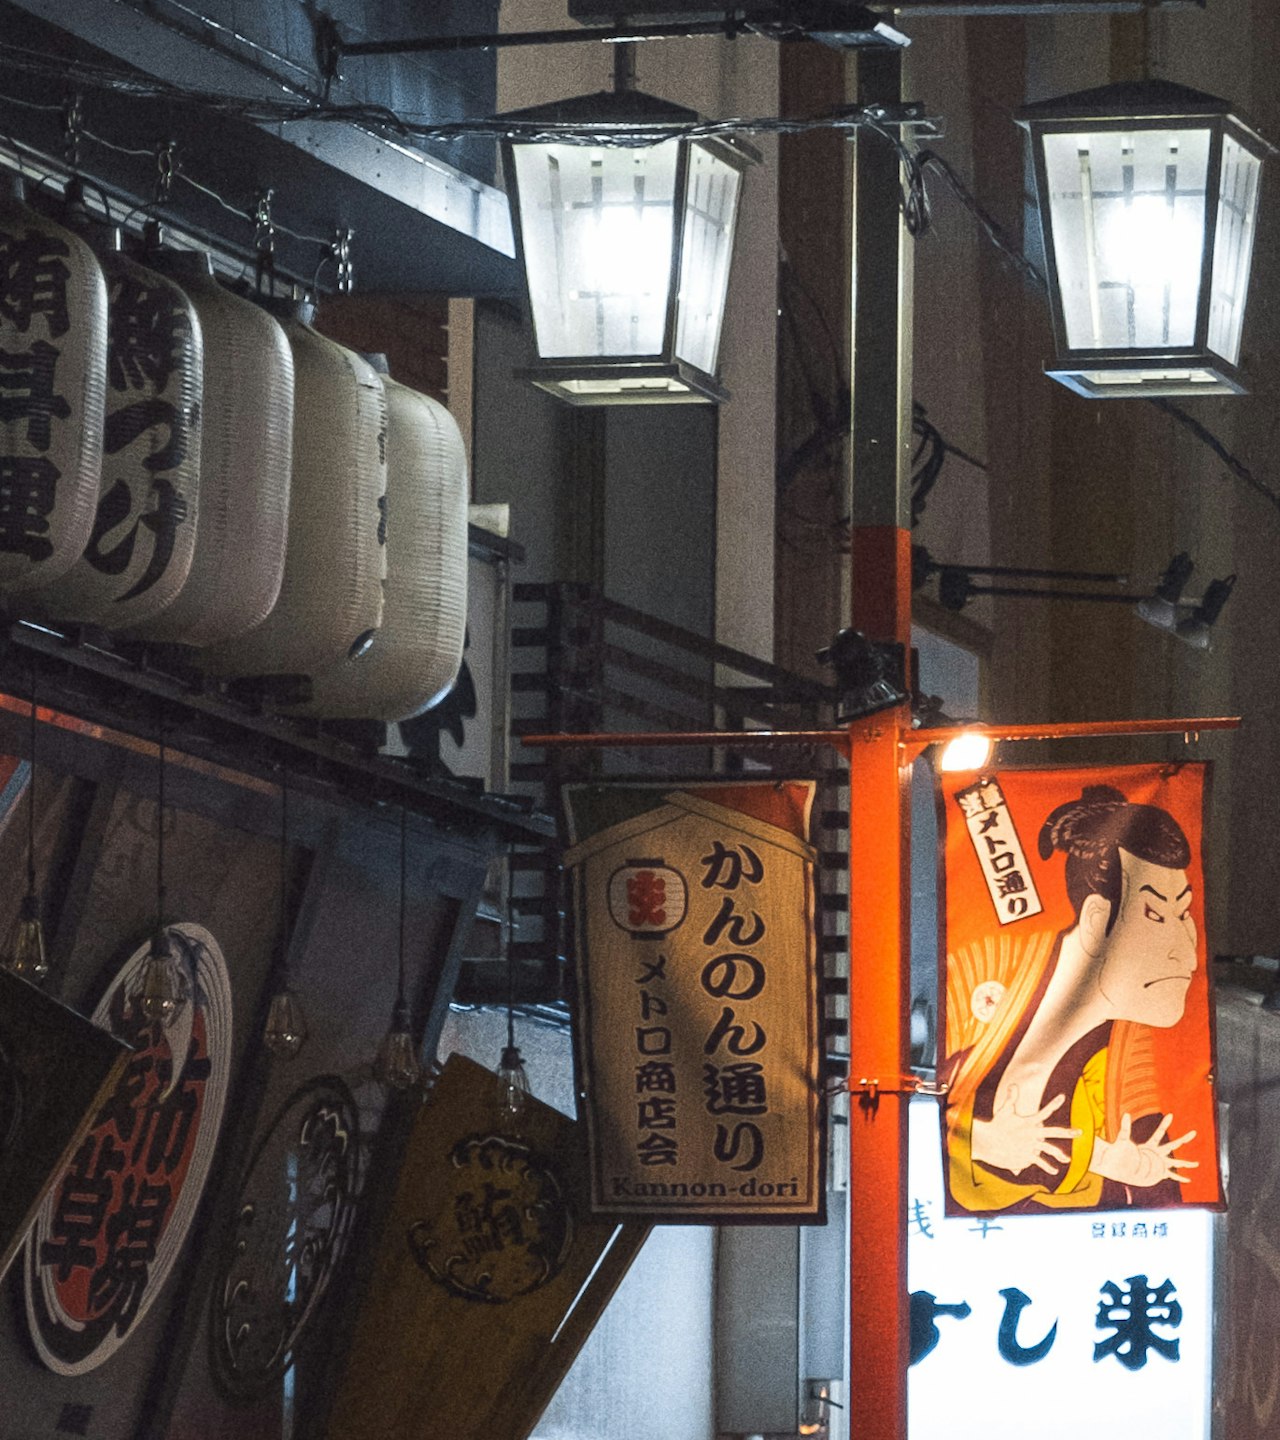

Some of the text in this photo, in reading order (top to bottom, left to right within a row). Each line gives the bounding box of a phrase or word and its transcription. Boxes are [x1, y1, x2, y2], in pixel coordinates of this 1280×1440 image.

[977, 810, 1029, 918] メトロ通り
[634, 954, 678, 1167] メトロ商店会
[700, 840, 769, 1172] かんのん通り
[612, 1177, 799, 1199] Kannon-dori
